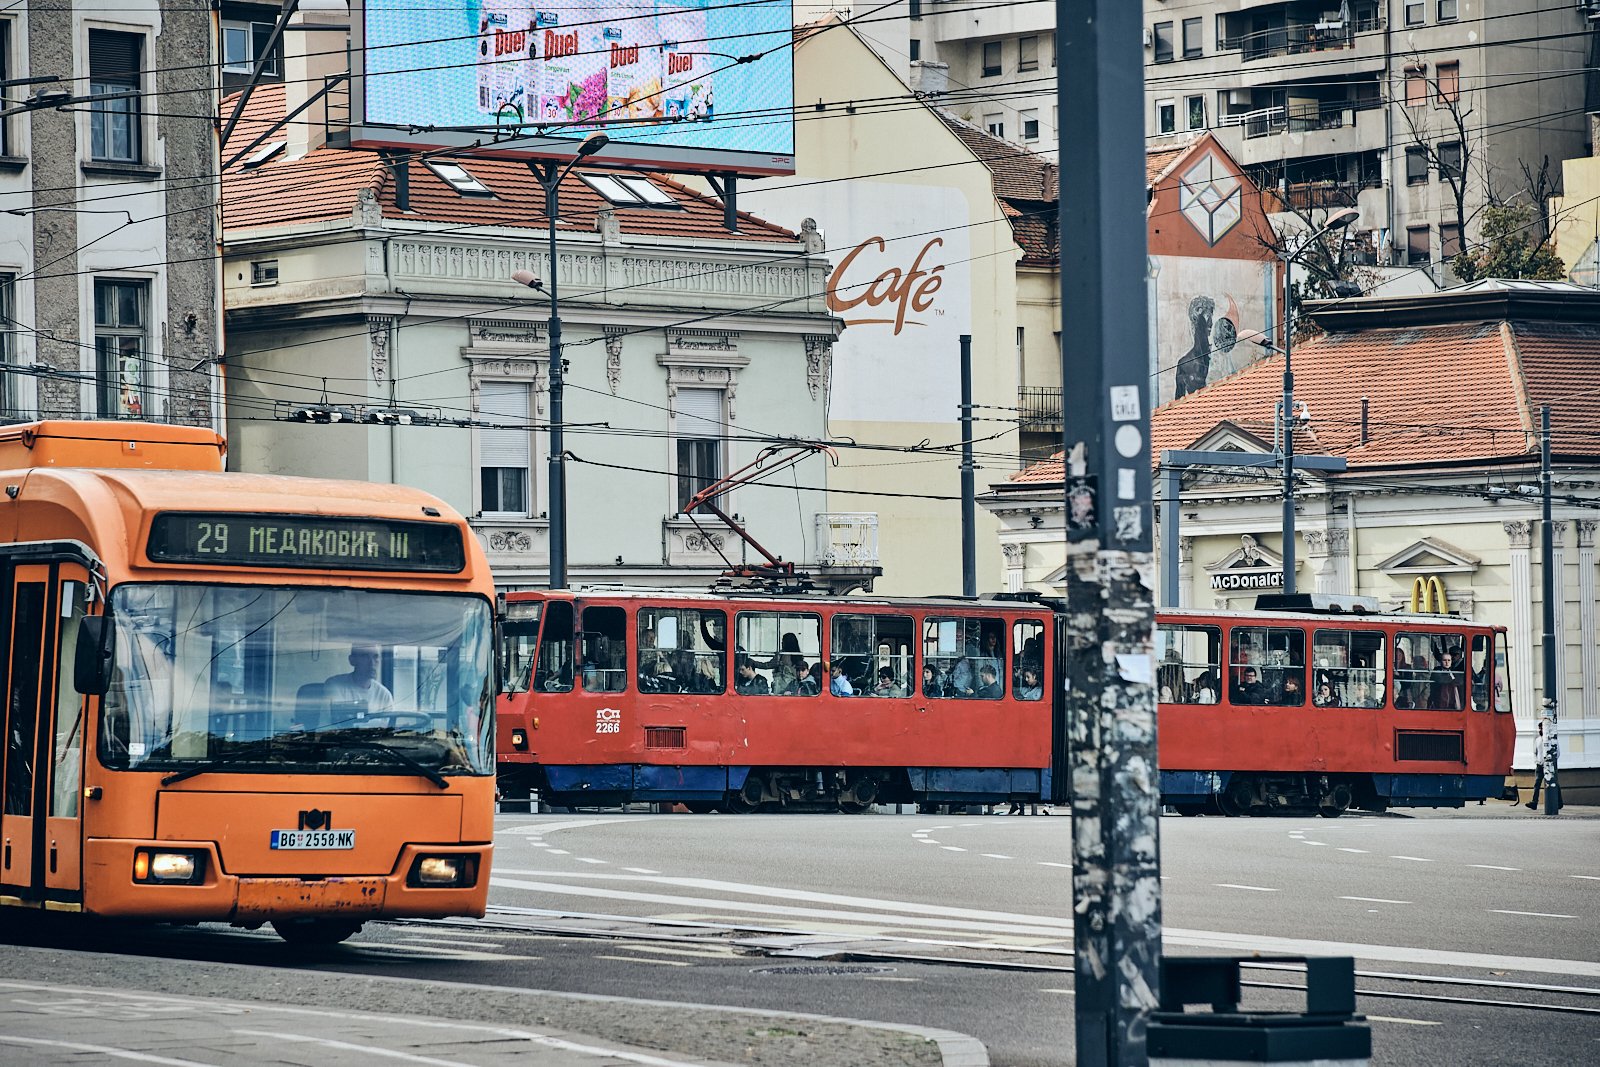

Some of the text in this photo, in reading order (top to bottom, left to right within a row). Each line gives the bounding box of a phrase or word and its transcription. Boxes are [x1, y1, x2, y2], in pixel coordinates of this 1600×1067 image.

[495, 28, 526, 56] Duel
[544, 29, 578, 61] Duel
[610, 43, 638, 69] Duel
[668, 52, 692, 75] Duel
[547, 108, 557, 119] 30
[827, 236, 945, 336] Café
[197, 523, 228, 553] 29
[250, 527, 379, 558] МЕДАКОВИЋ
[596, 723, 620, 734] 2266
[281, 833, 296, 847] BG
